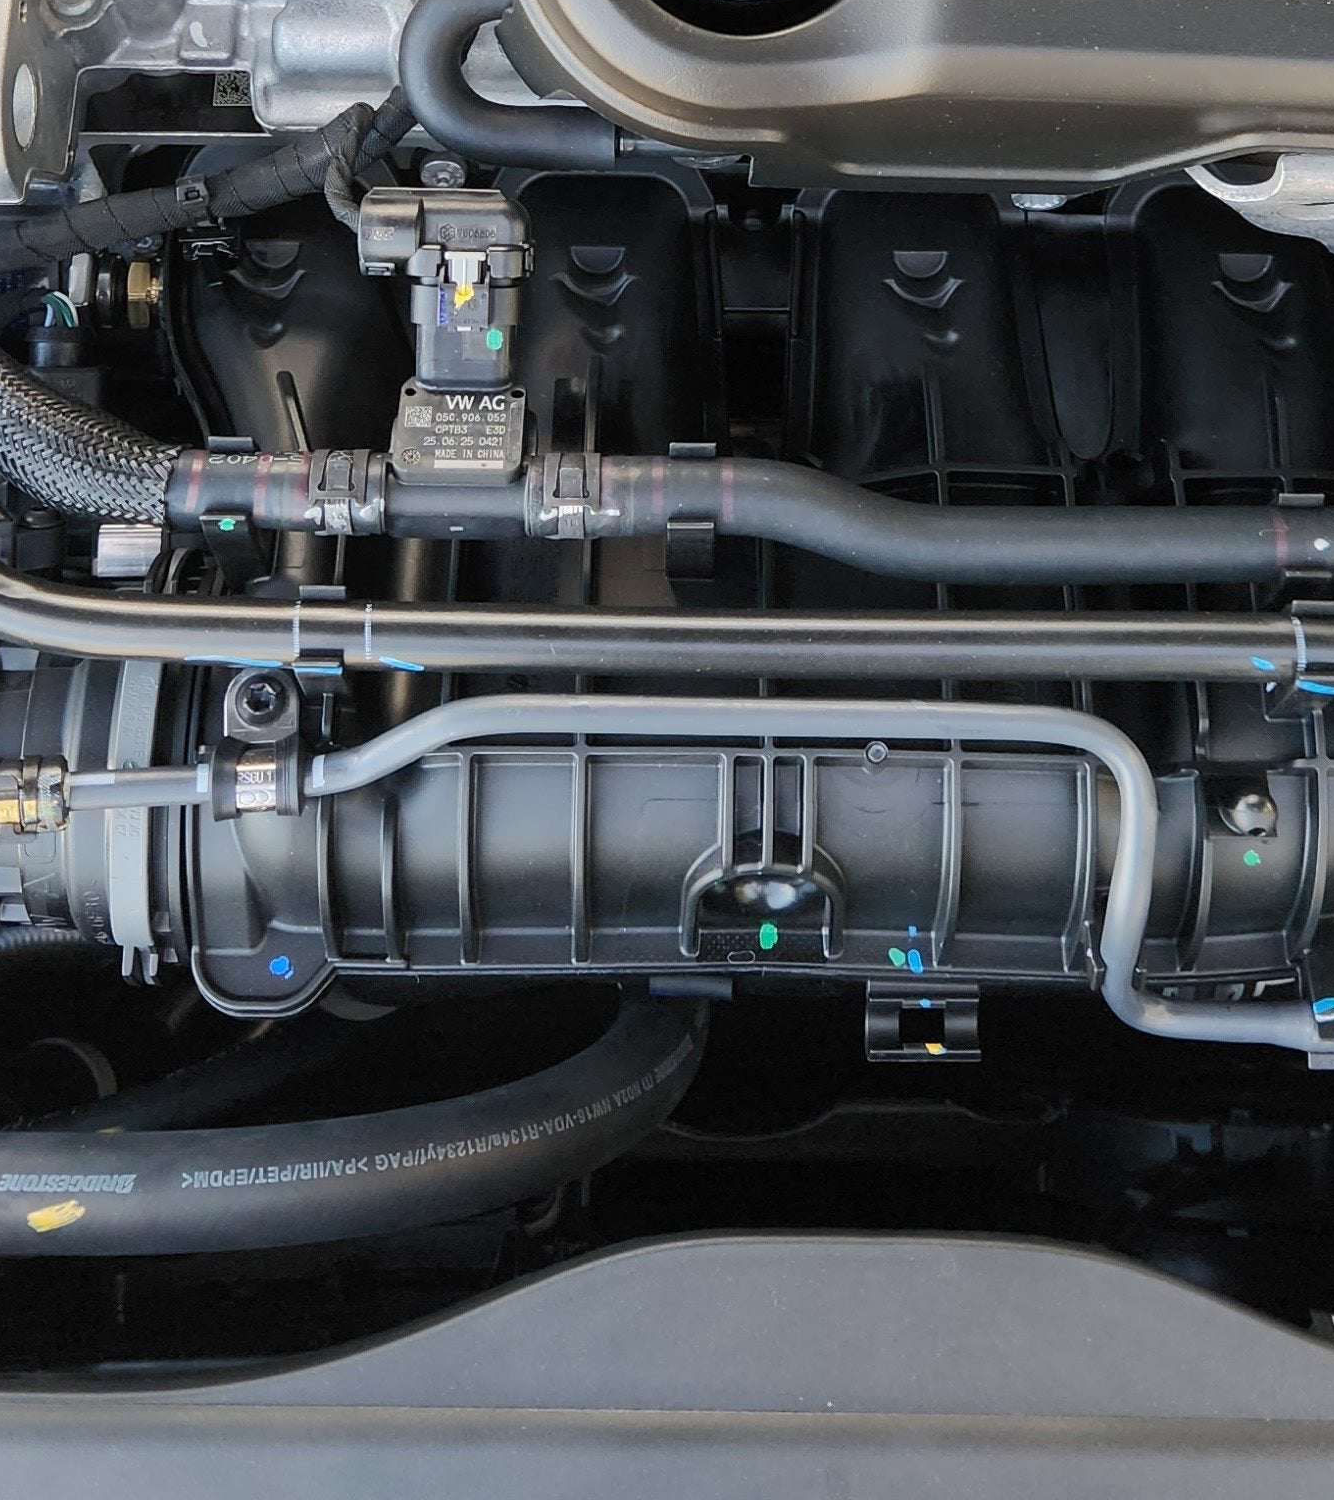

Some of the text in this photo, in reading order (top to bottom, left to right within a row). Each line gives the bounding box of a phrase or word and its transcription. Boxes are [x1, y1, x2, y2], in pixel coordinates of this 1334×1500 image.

[444, 394, 506, 410] VW AG
[435, 425, 506, 435] CPTB3 E3D
[423, 436, 504, 447] 25.06.25 0421
[434, 448, 504, 459] MADE IN CHINA
